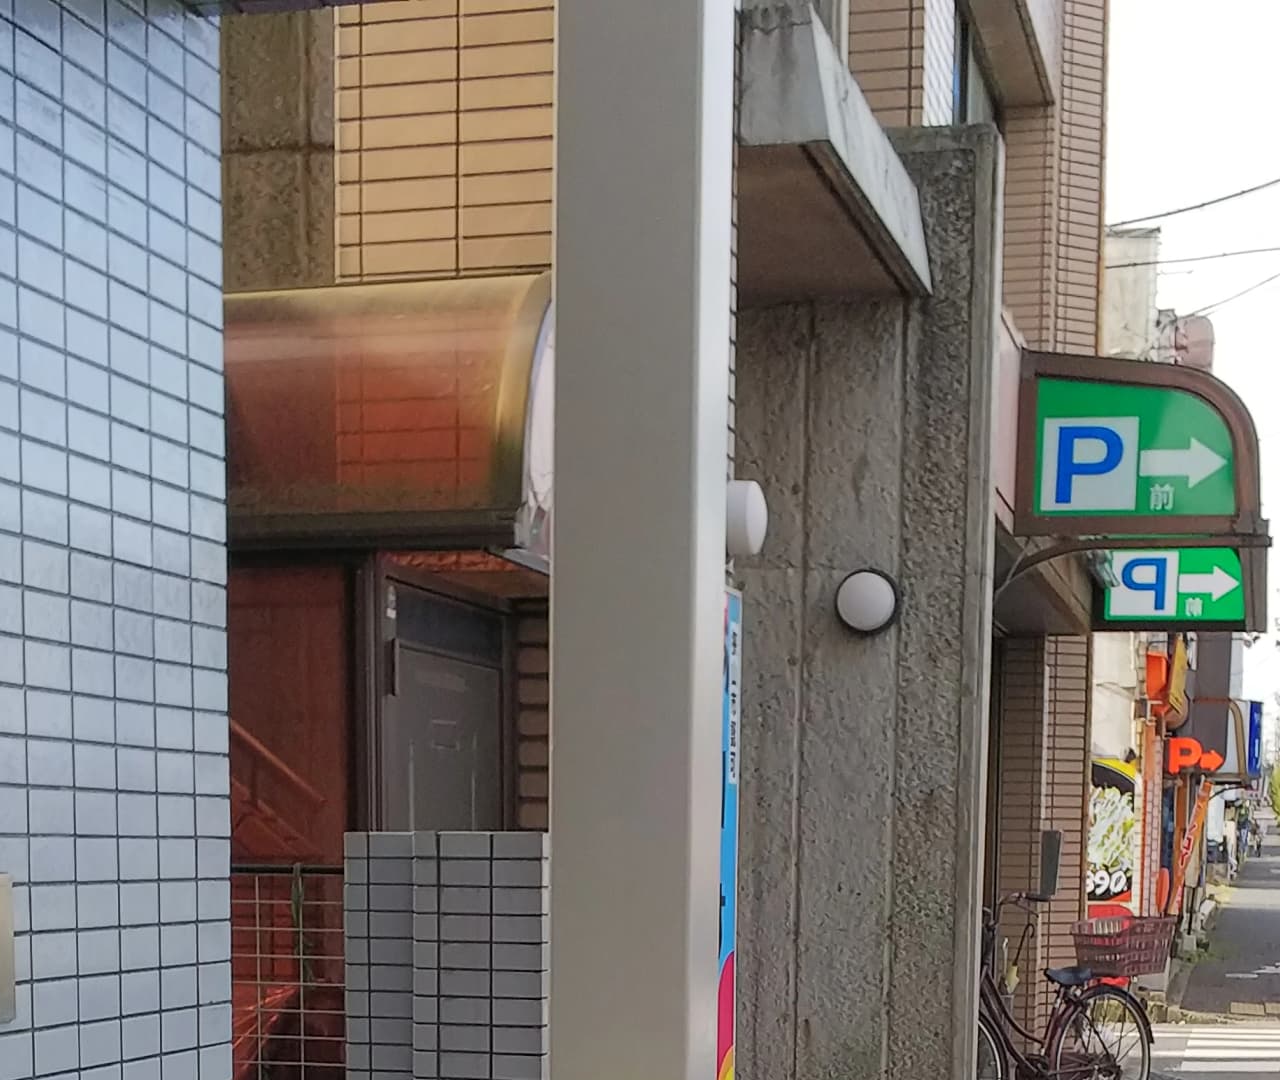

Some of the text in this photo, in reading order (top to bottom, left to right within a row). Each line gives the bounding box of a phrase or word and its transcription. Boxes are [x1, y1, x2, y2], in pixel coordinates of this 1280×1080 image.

[1055, 426, 1125, 505] P
[1149, 483, 1175, 511] 前
[1169, 737, 1202, 775] P
